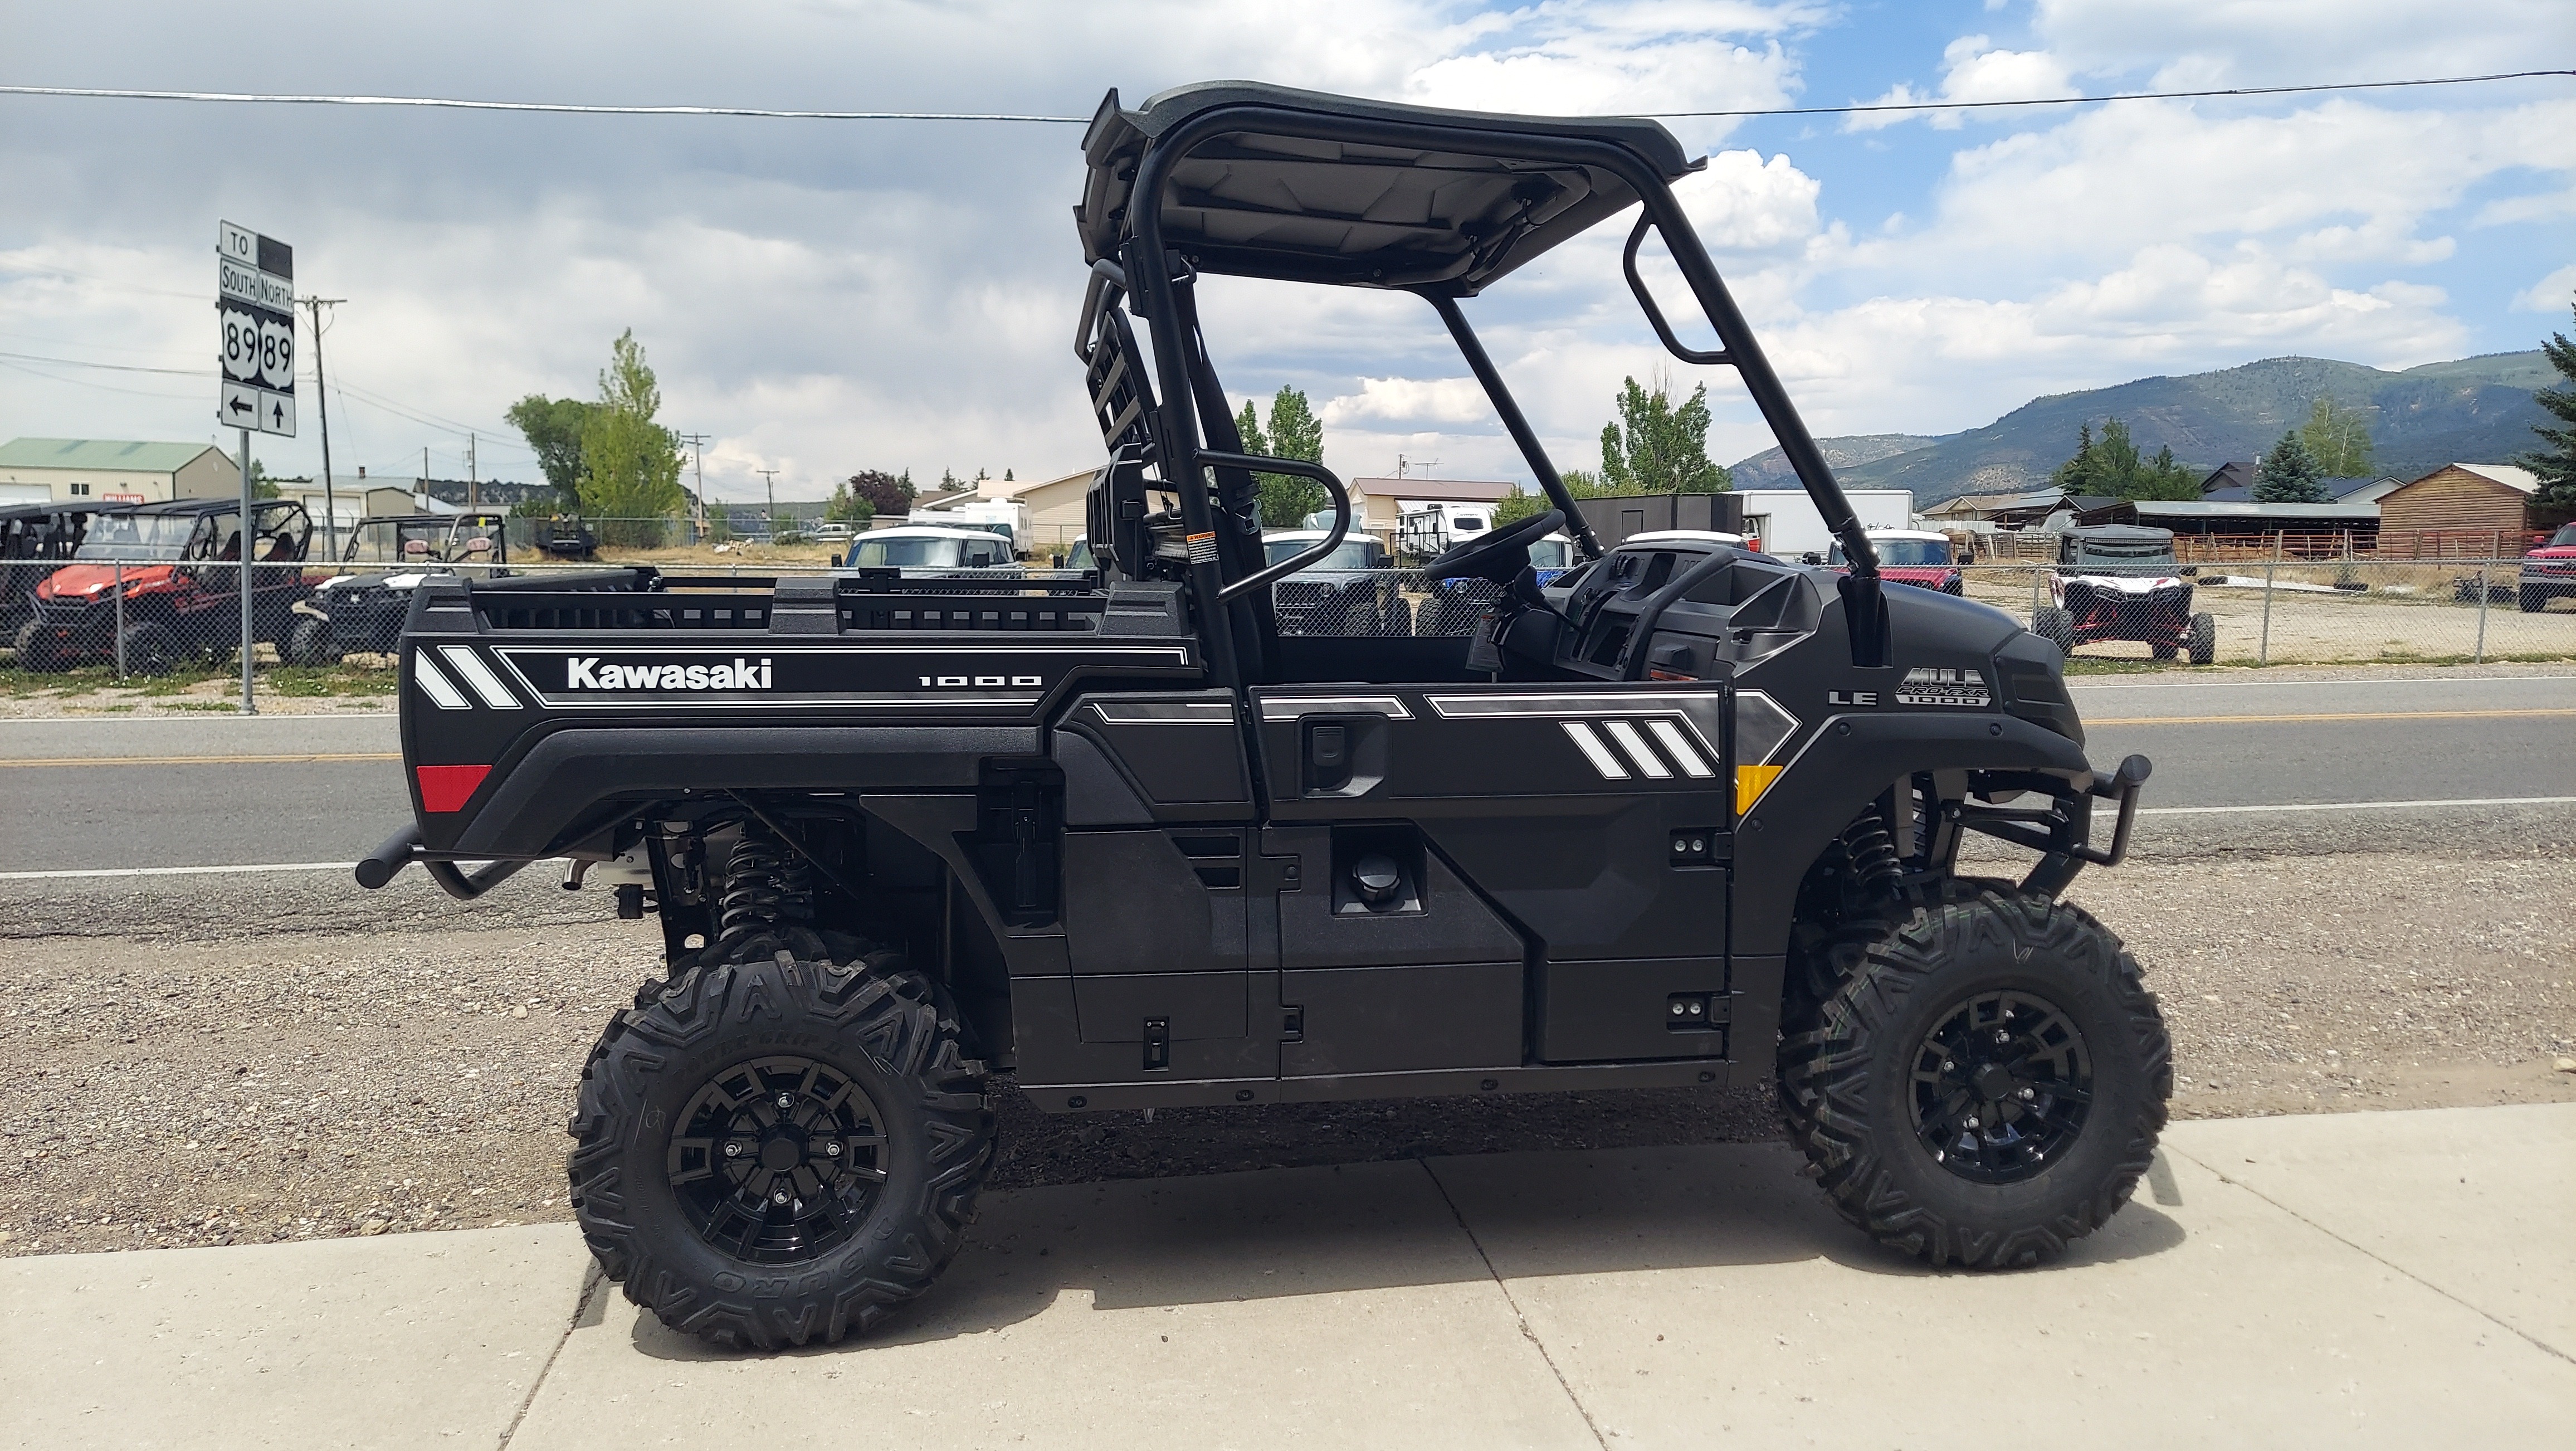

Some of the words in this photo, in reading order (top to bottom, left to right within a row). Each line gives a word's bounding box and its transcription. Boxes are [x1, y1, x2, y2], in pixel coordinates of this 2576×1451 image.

[231, 231, 248, 256] TO
[223, 265, 256, 297] SOUTH
[261, 278, 292, 308] NORTH
[227, 322, 256, 364] 89
[264, 335, 291, 372] 89
[568, 658, 772, 689] Kawasaki
[919, 676, 1042, 686] 1000
[1901, 668, 1988, 688] MULE
[1828, 691, 1877, 705] LE
[1895, 686, 1989, 696] PRO-FXR
[1907, 695, 1980, 704] 1000
